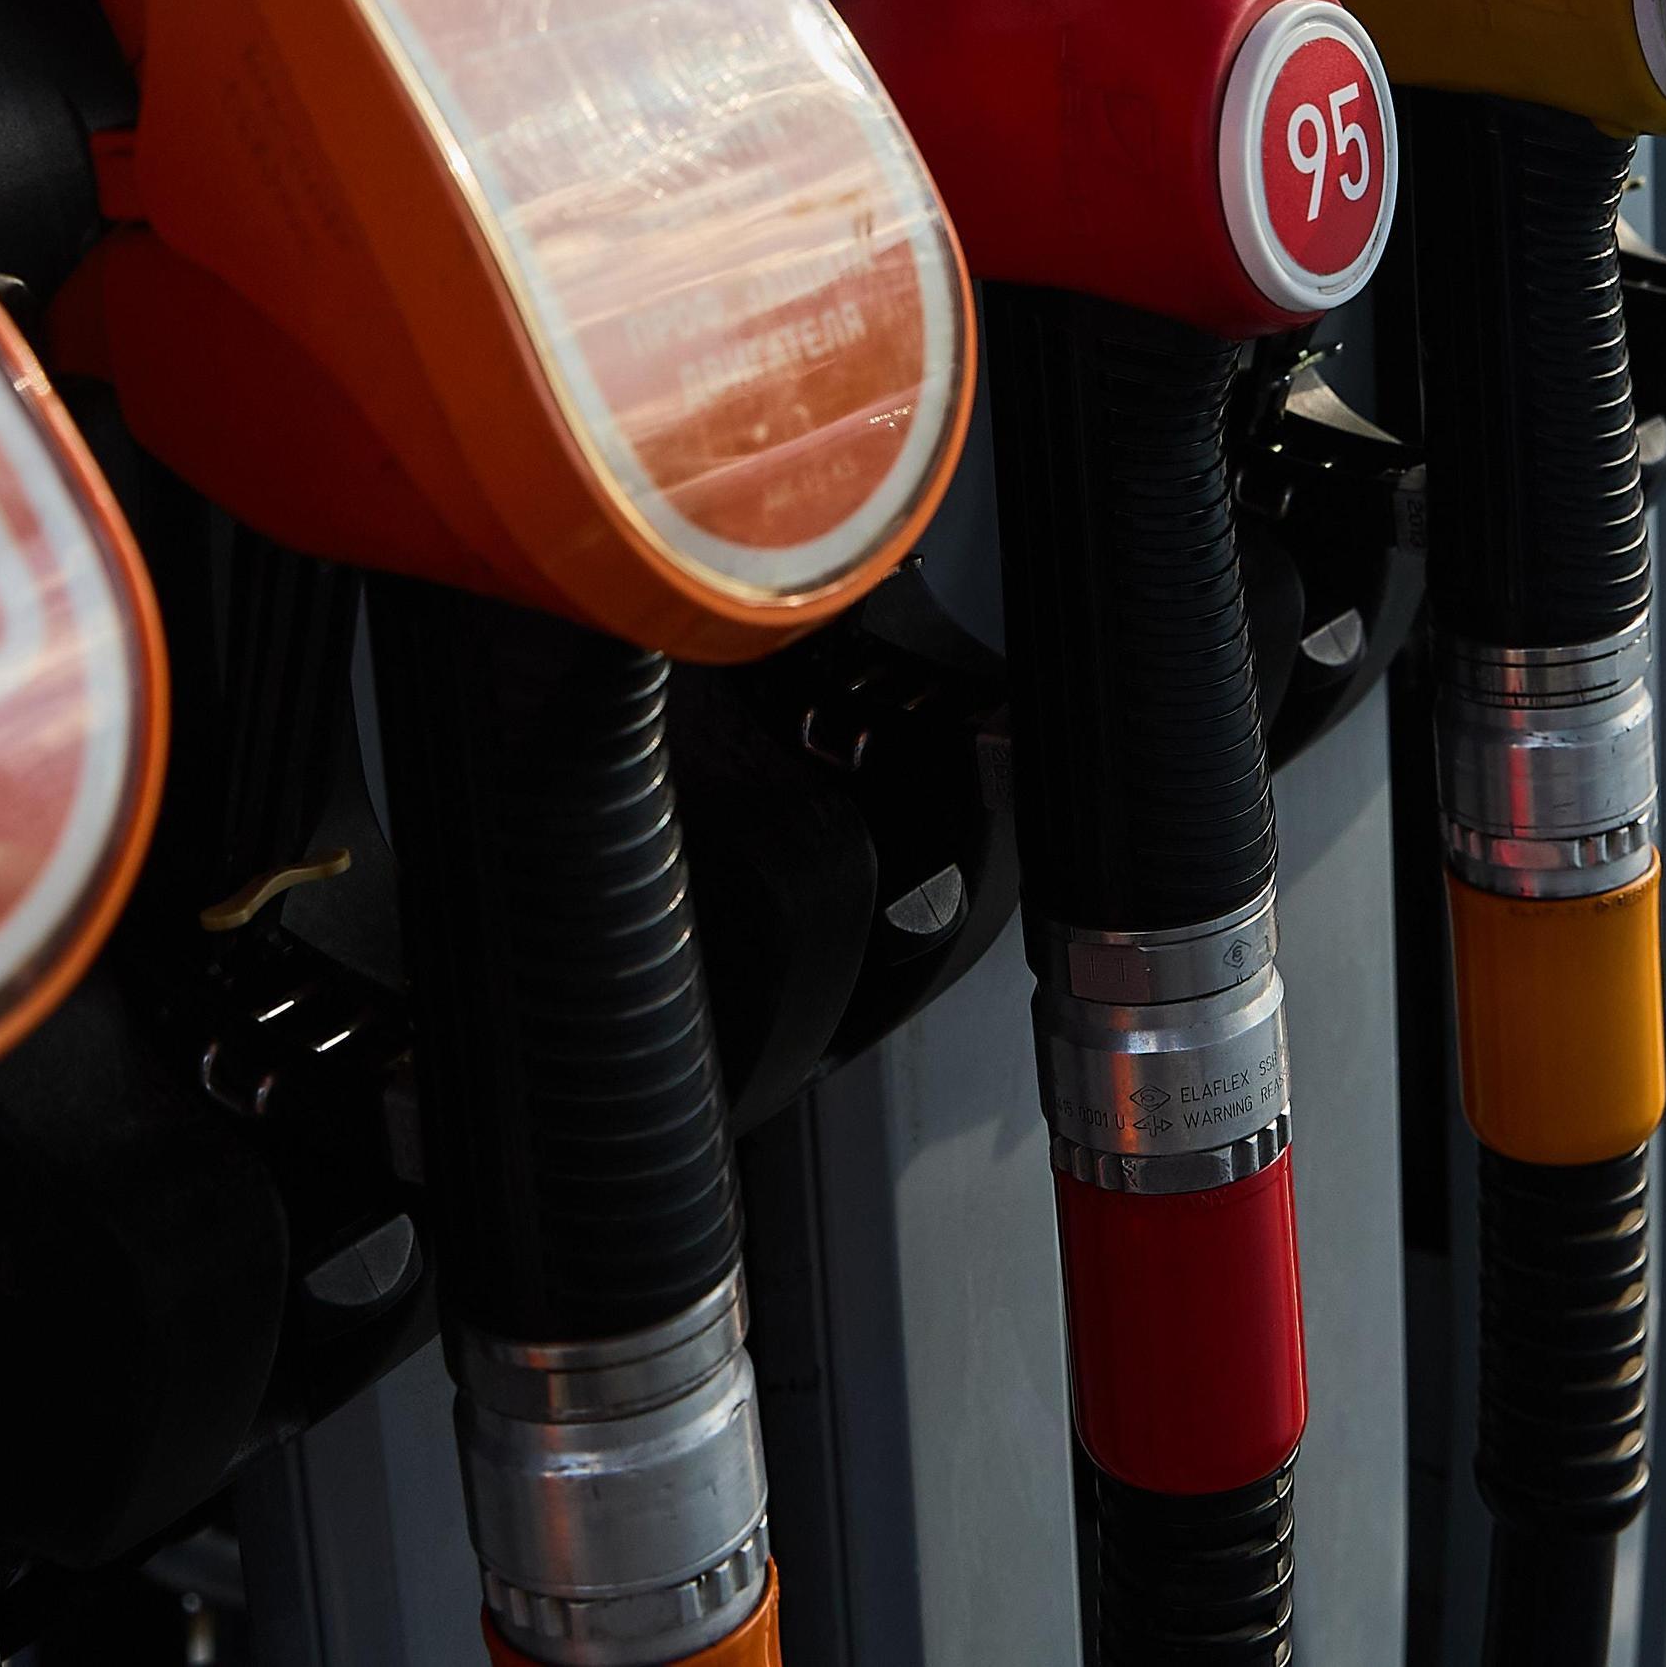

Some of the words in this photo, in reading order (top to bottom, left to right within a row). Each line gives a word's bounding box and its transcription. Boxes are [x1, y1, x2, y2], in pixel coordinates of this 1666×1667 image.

[1286, 81, 1371, 223] 95
[1180, 1069, 1250, 1103] ELAFLEX
[1182, 1094, 1254, 1129] WARNING
